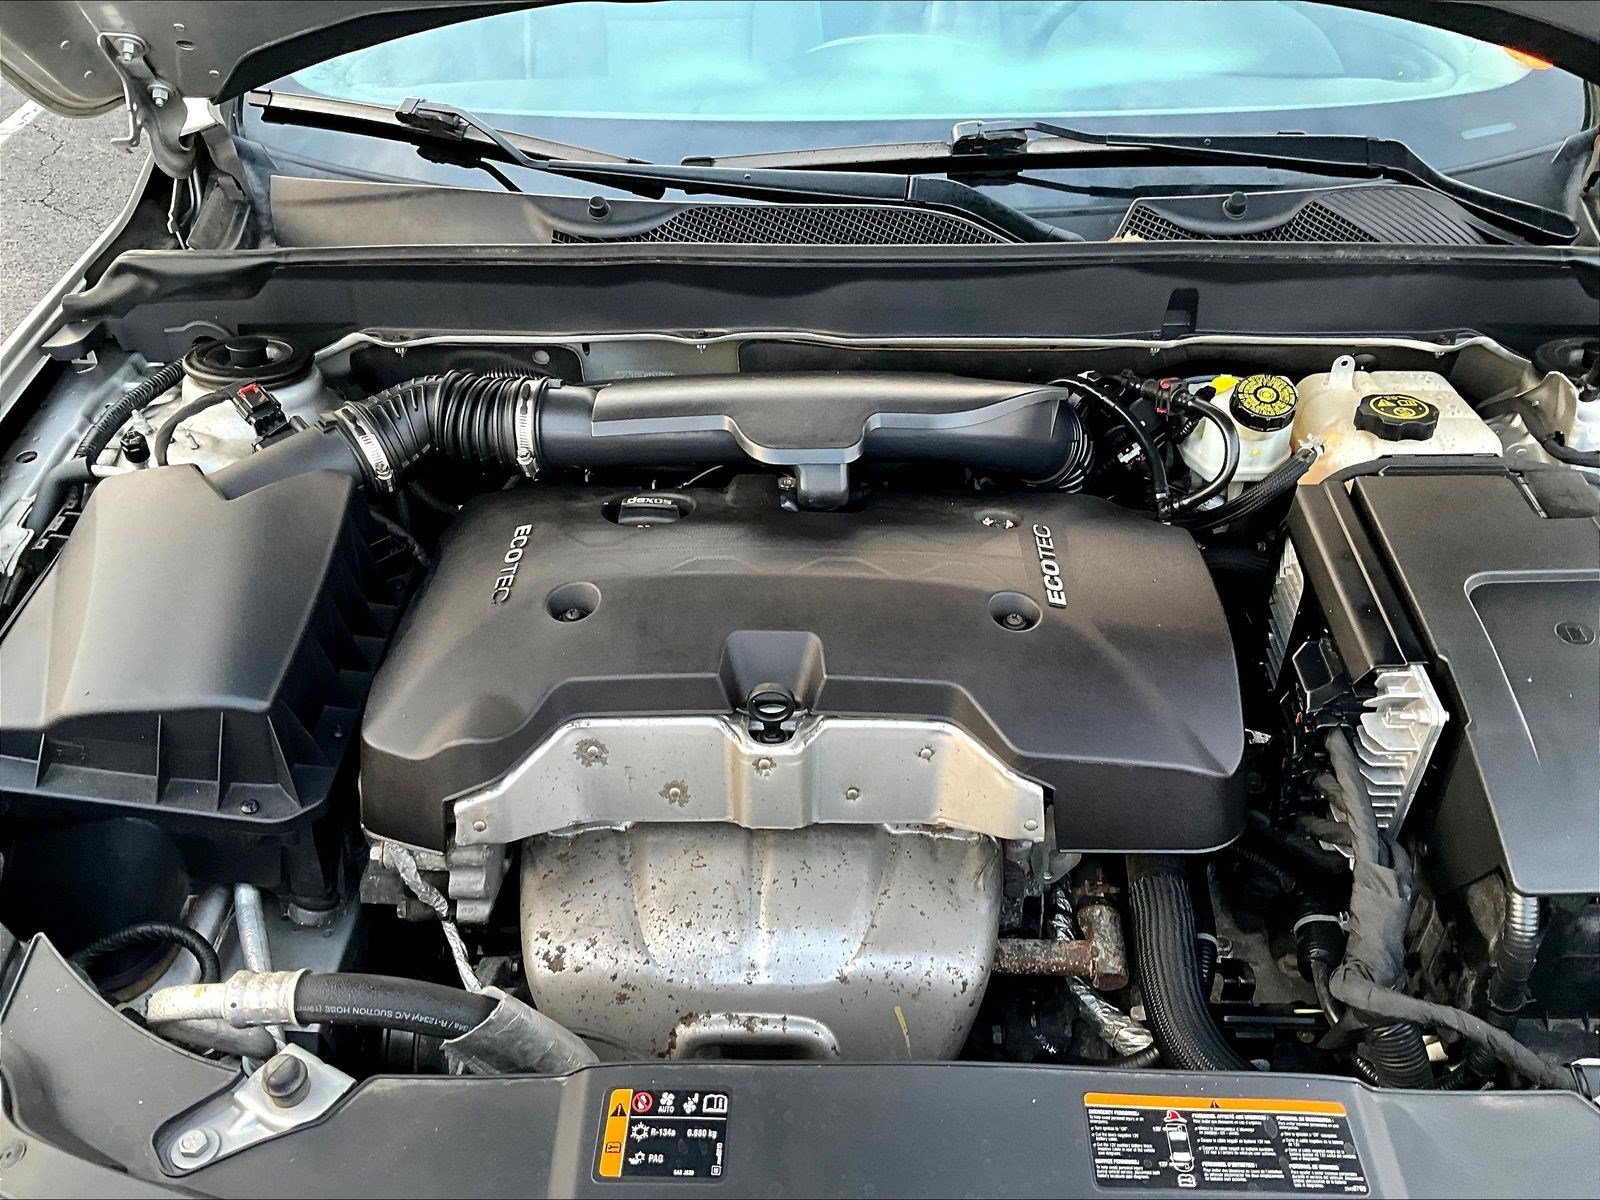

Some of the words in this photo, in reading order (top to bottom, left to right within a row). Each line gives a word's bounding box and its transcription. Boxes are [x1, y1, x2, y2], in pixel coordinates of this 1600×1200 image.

[491, 523, 533, 603] ECOTEC
[1033, 524, 1067, 607] ECOTEC
[325, 1005, 350, 1015] HOSE
[352, 1006, 393, 1018] SUCTION
[394, 1011, 411, 1020] A/C
[658, 1105, 675, 1114] AUTO
[650, 1127, 676, 1137] R-134a
[708, 1129, 718, 1140] kg
[648, 1153, 664, 1163] PAG
